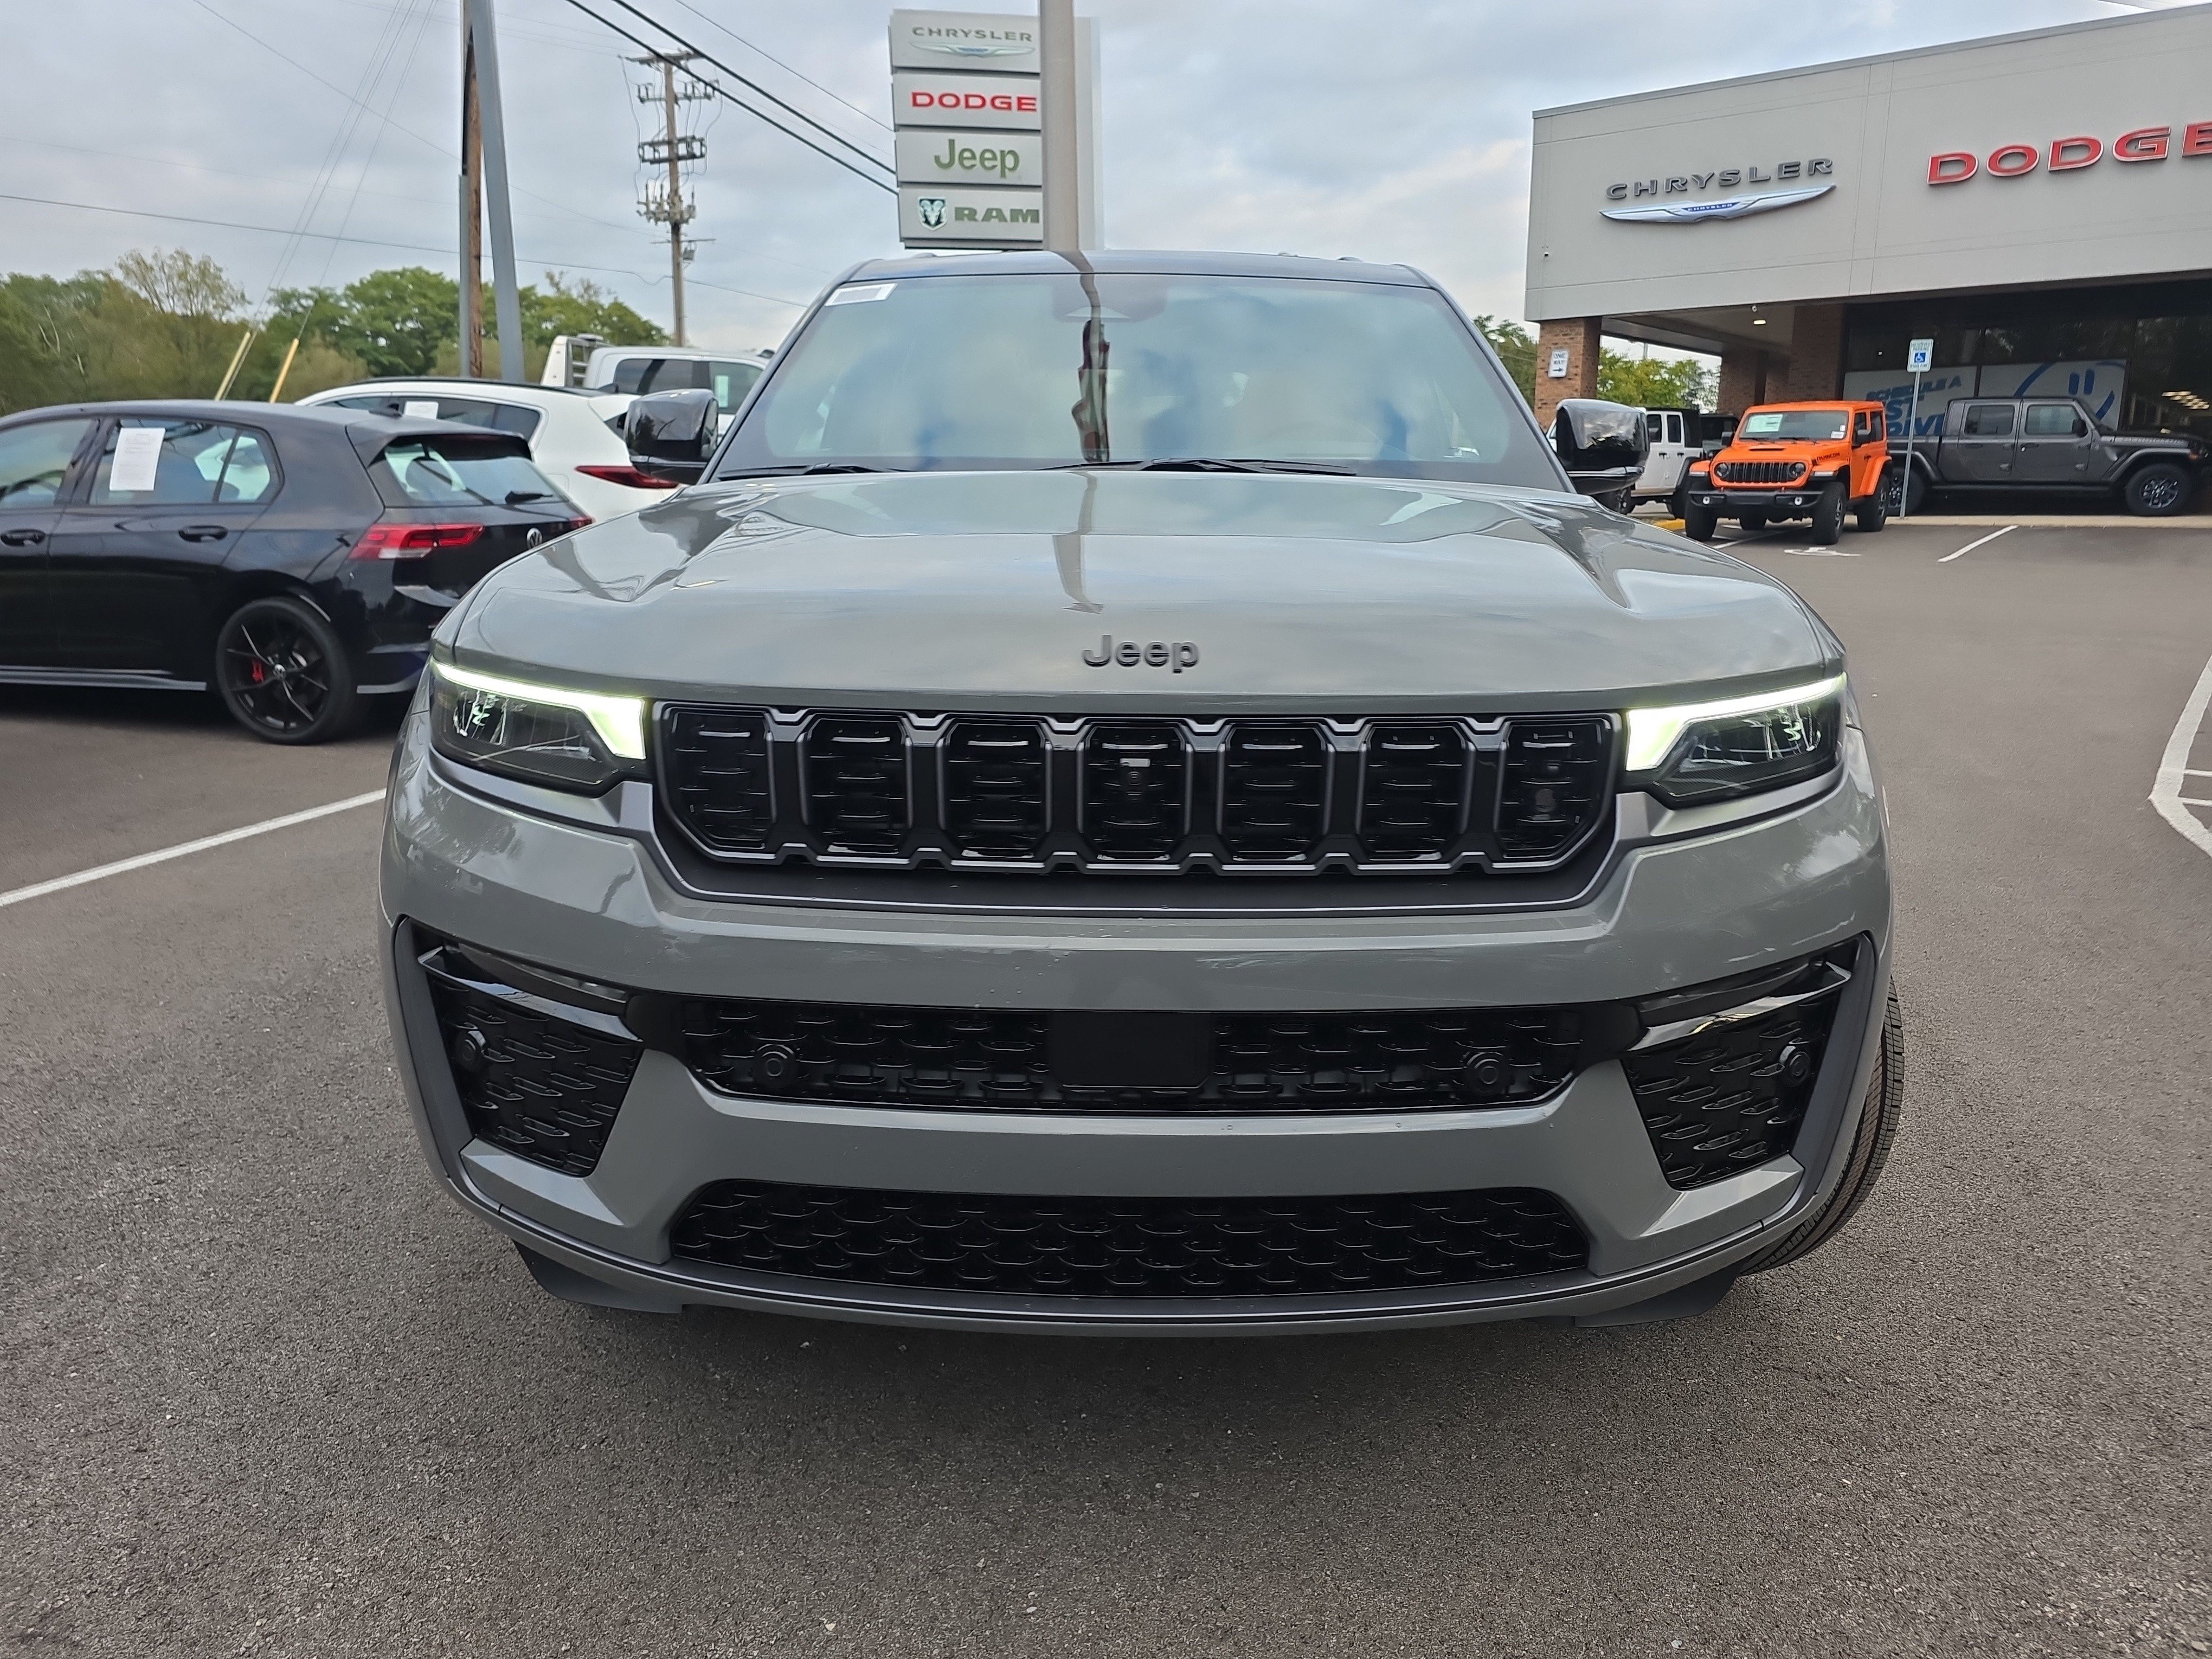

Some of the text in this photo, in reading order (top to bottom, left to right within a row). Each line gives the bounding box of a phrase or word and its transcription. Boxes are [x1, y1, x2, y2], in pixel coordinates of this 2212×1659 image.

[911, 26, 1032, 42] CHRYSLER
[911, 91, 1037, 112] DODGE
[934, 138, 1020, 178] Jeep
[1927, 120, 2212, 185] DODGE
[1605, 158, 1833, 200] CHRYSLER
[954, 207, 1040, 223] RAM
[1082, 634, 1200, 674] Jeep
